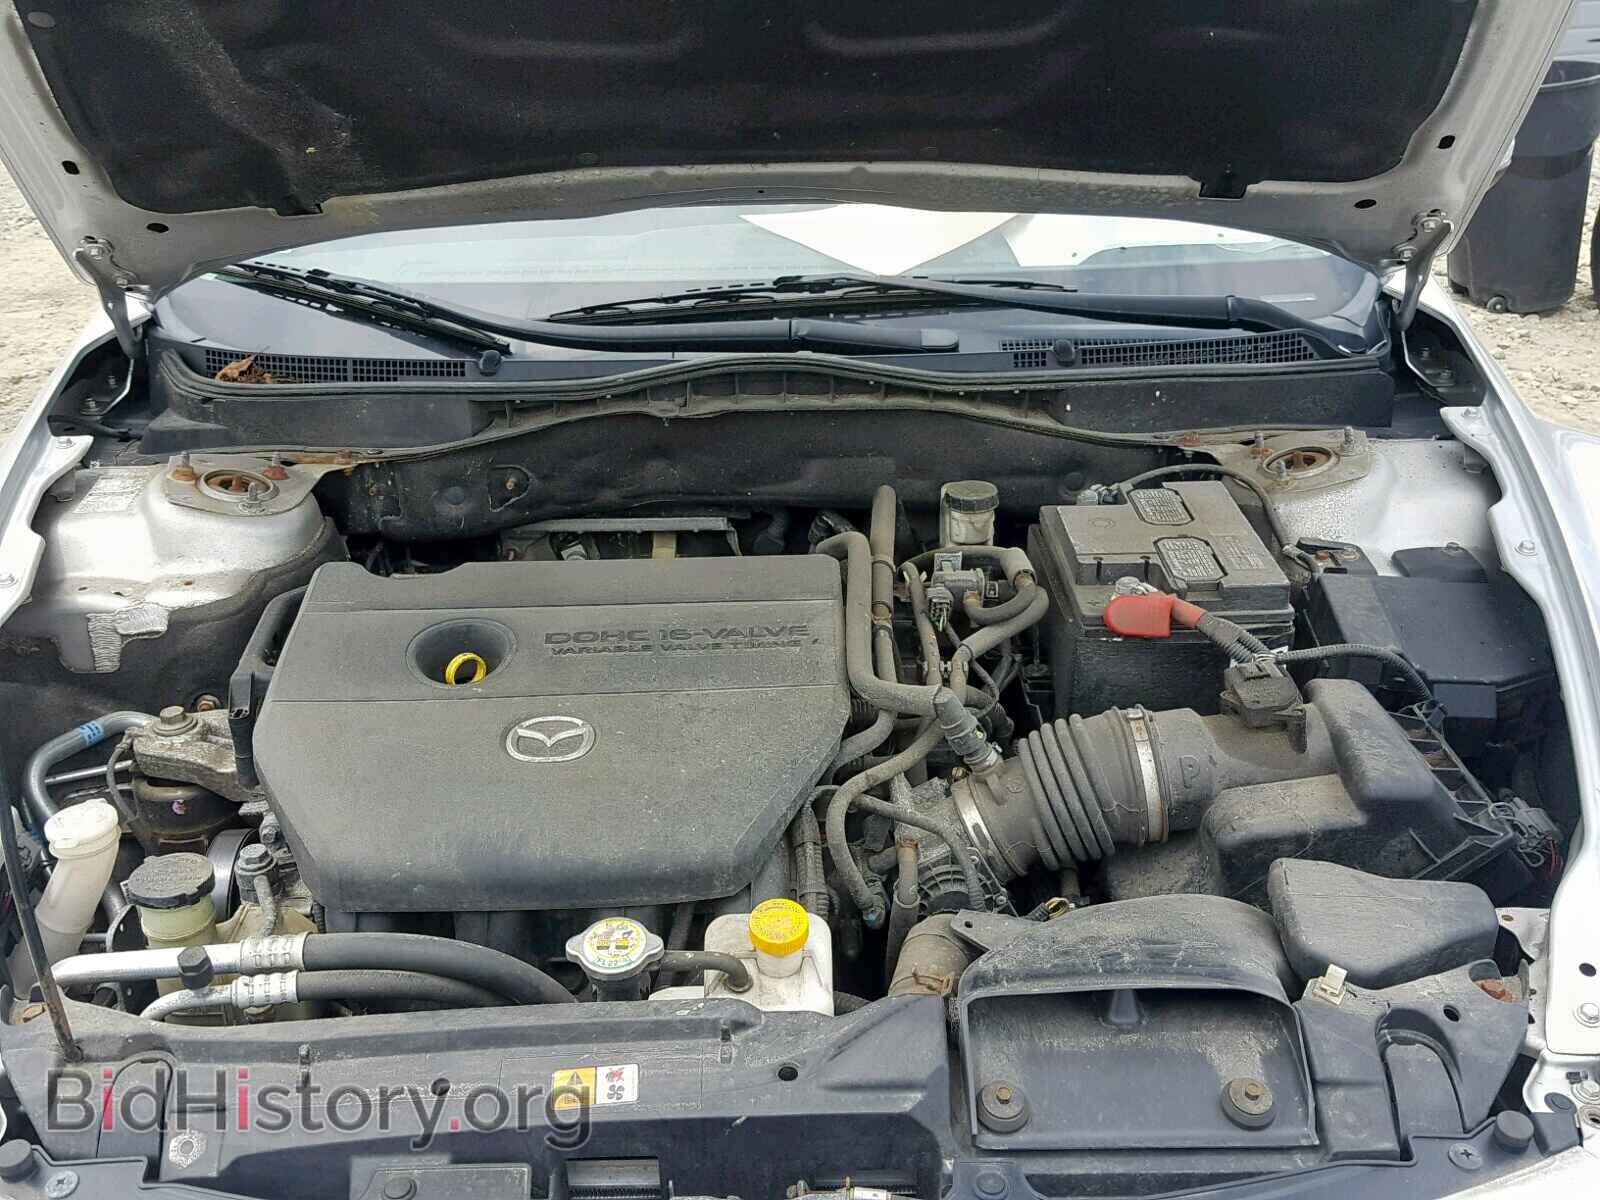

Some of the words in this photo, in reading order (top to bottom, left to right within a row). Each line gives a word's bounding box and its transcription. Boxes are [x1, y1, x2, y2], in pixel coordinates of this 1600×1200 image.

[544, 630, 650, 645] DOHC
[658, 625, 811, 641] 16-VALVE
[551, 643, 653, 656] VARIABLE
[660, 641, 723, 652] VALVE
